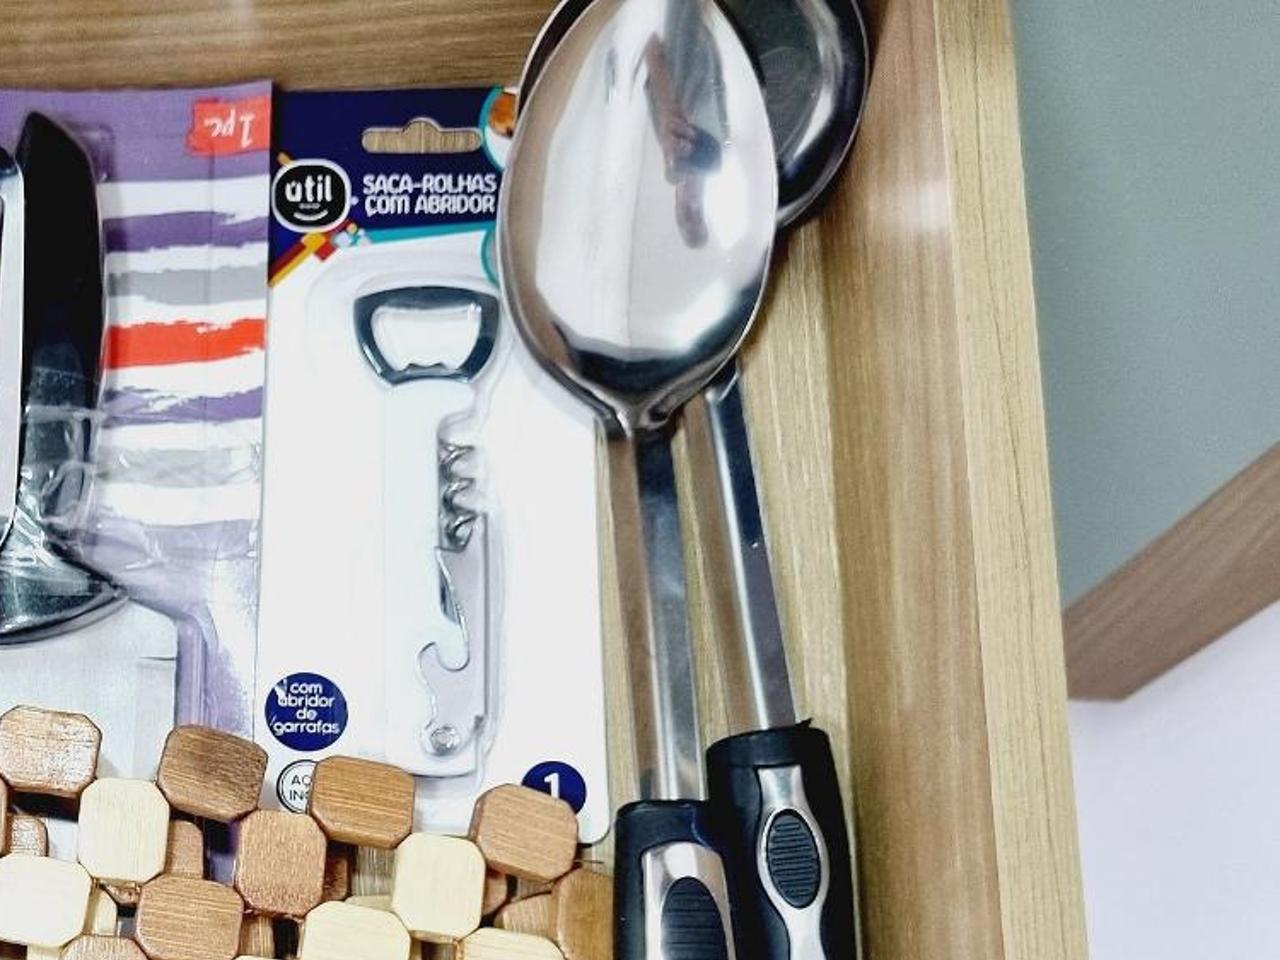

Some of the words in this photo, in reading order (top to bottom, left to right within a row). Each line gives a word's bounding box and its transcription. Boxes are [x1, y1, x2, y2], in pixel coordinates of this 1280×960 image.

[363, 173, 497, 195] SACA-ROLHAS
[414, 193, 496, 215] ABRIDOR
[290, 682, 323, 695] com
[278, 695, 336, 709] abridor
[296, 708, 318, 721] de
[273, 720, 340, 736] garrafas
